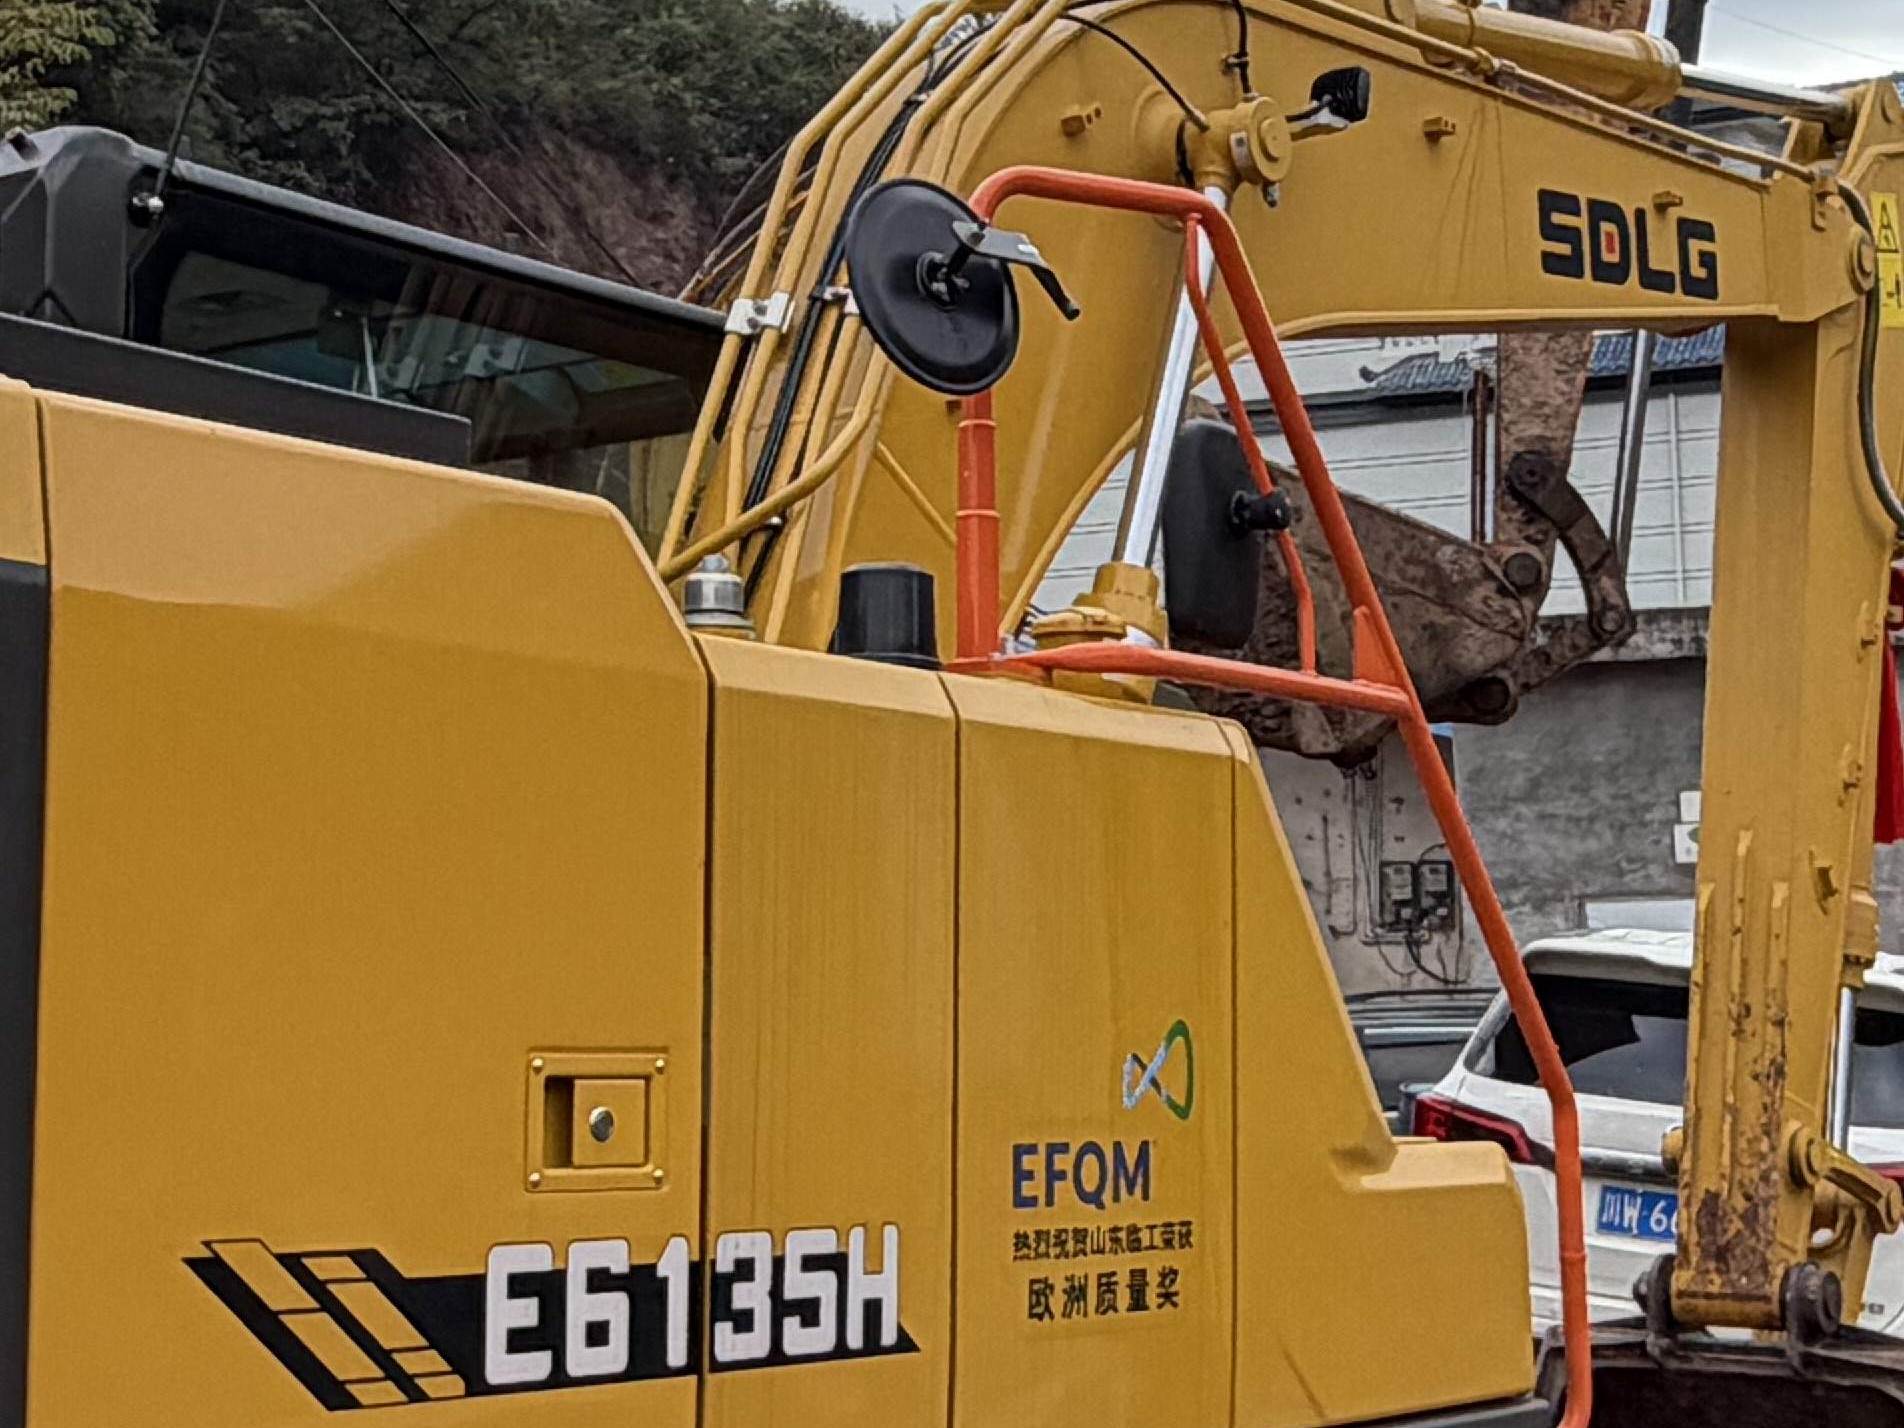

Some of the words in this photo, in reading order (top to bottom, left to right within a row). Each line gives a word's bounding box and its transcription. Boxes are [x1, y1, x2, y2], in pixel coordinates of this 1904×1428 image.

[1537, 188, 1718, 301] SDLG
[1012, 1140, 1151, 1210] EFQM
[1013, 1220, 1194, 1262] 热烈祝贺山东临工荣获
[484, 1222, 899, 1386] E6135H
[1027, 1265, 1180, 1322] 欧洲质量奖
